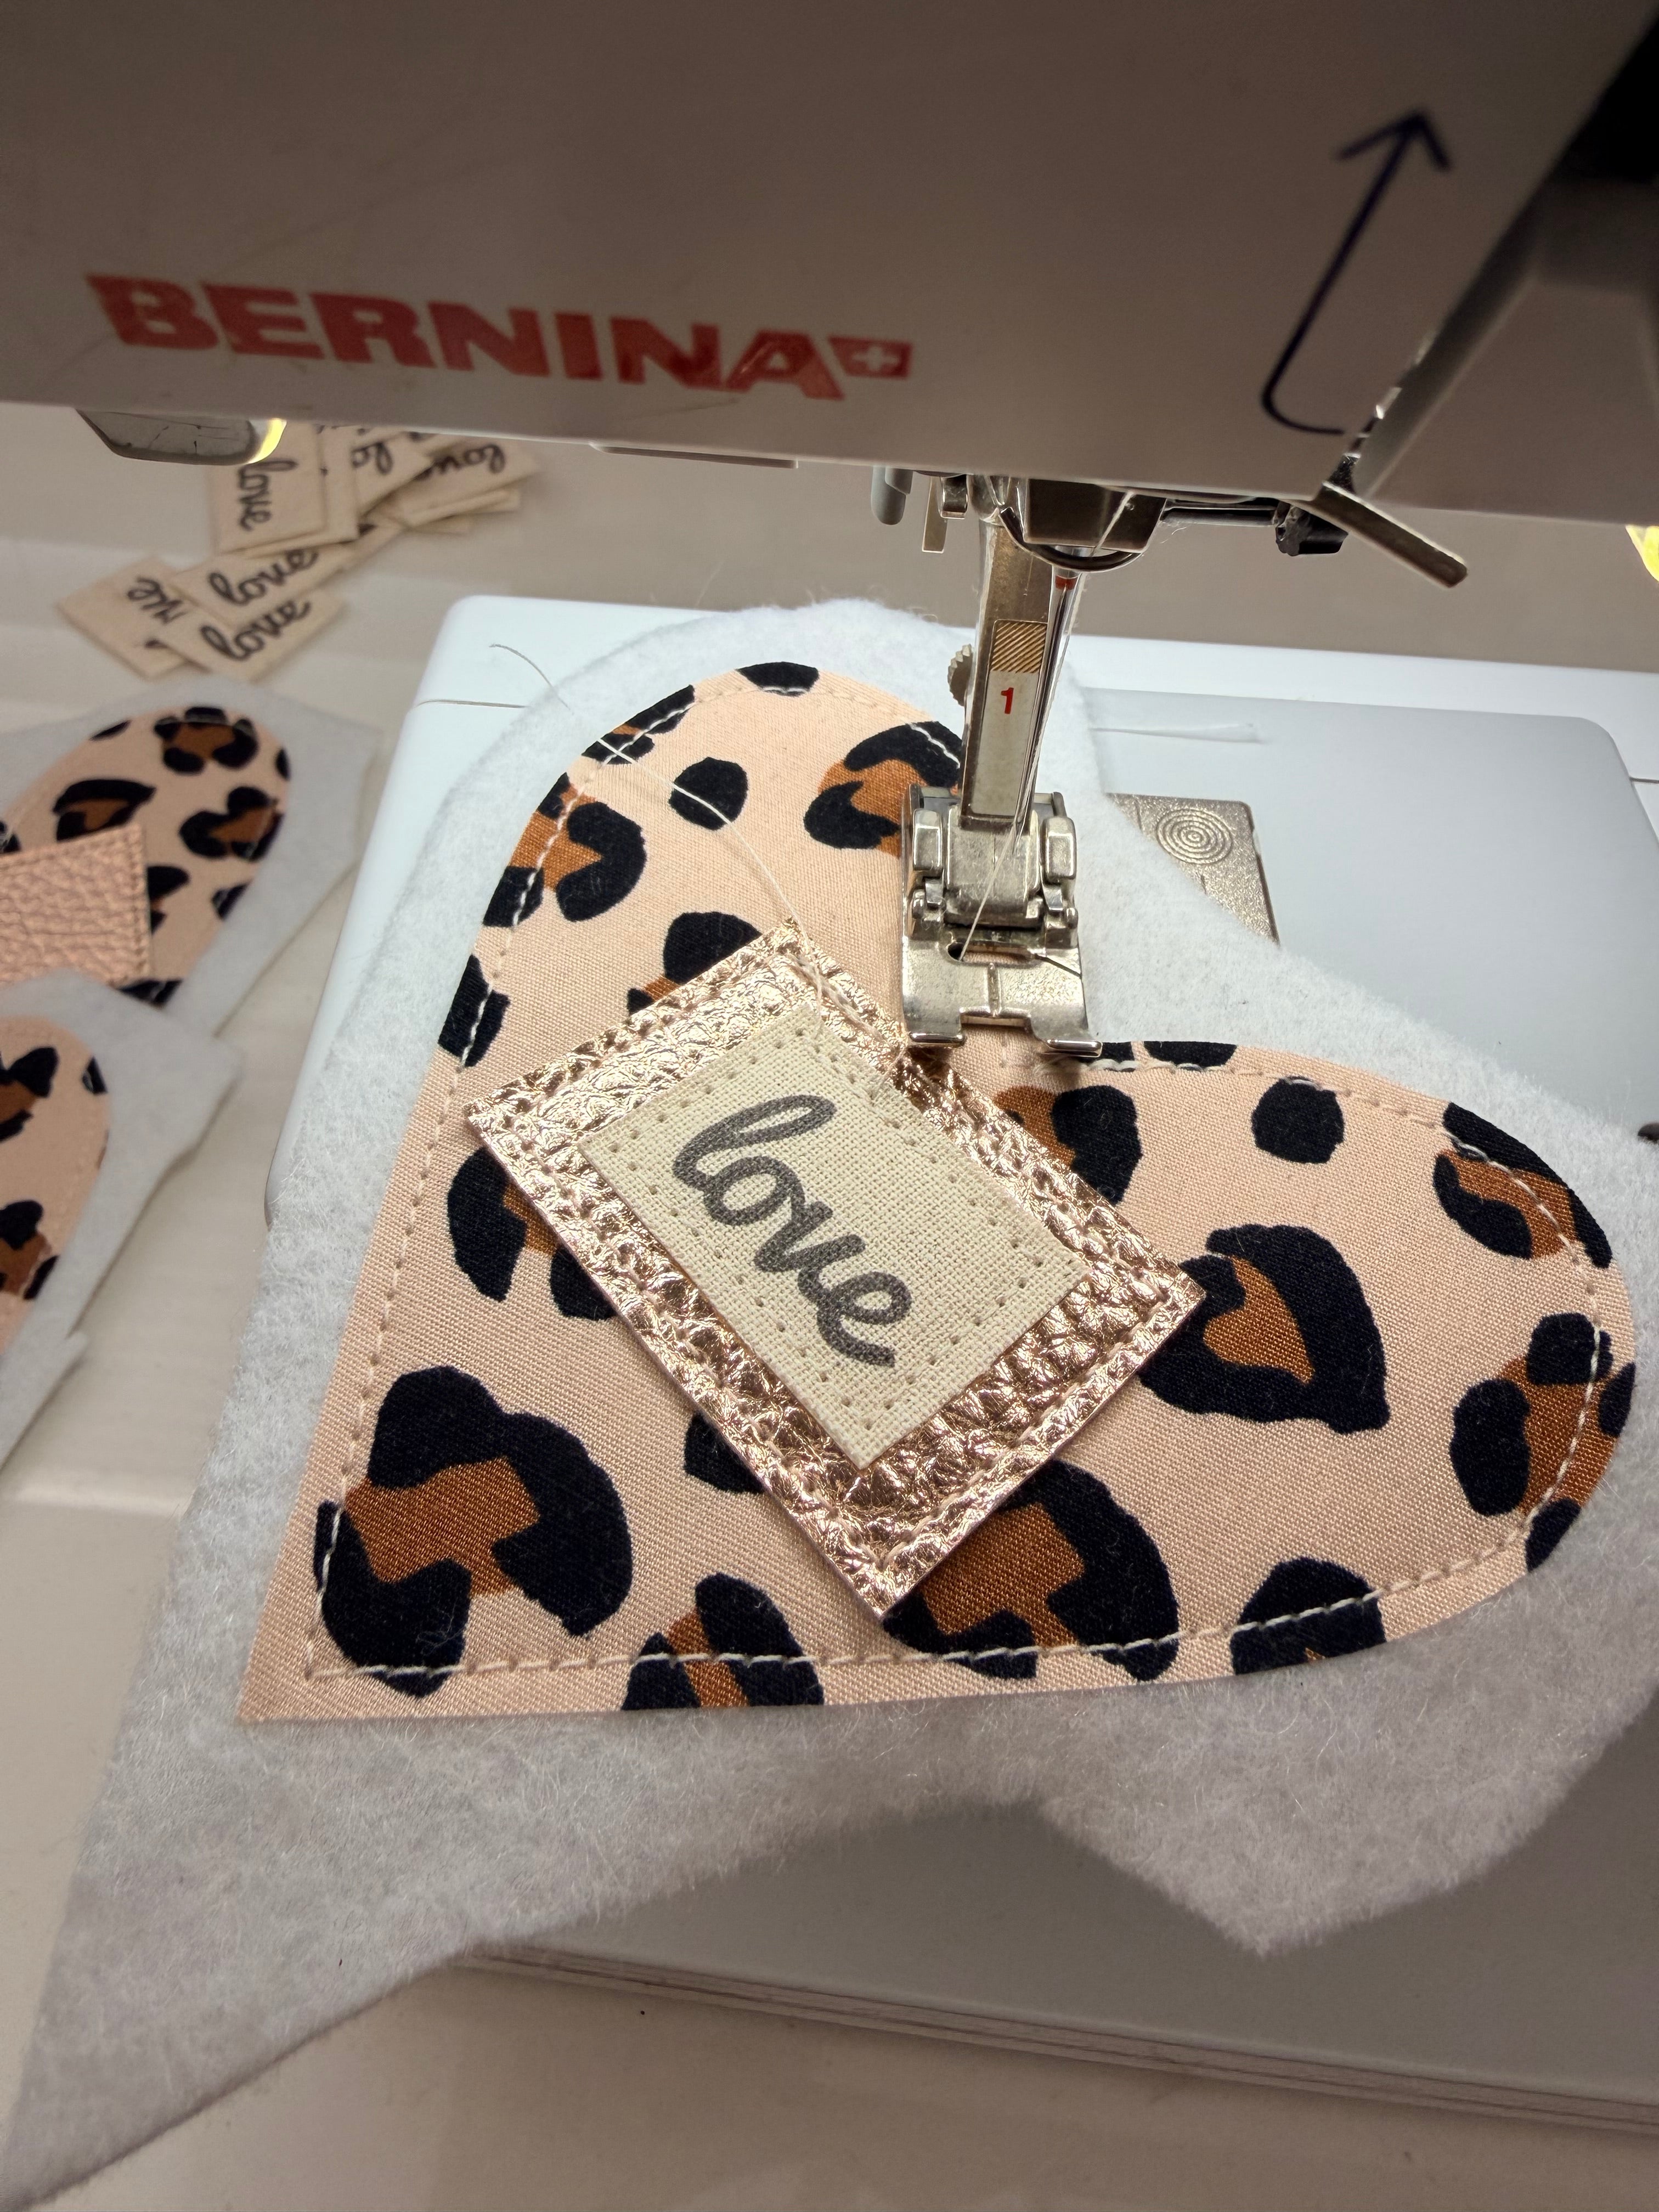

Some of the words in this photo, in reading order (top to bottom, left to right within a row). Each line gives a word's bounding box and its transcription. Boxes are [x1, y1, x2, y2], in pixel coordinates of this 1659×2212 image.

[90, 275, 843, 399] BERNINA
[351, 441, 394, 476] lo
[413, 443, 506, 483] lov
[238, 458, 300, 532] love
[127, 574, 188, 625] ve
[207, 549, 320, 607] love
[199, 600, 313, 662] love
[1001, 687, 1015, 714] 1
[672, 1094, 912, 1368] love
